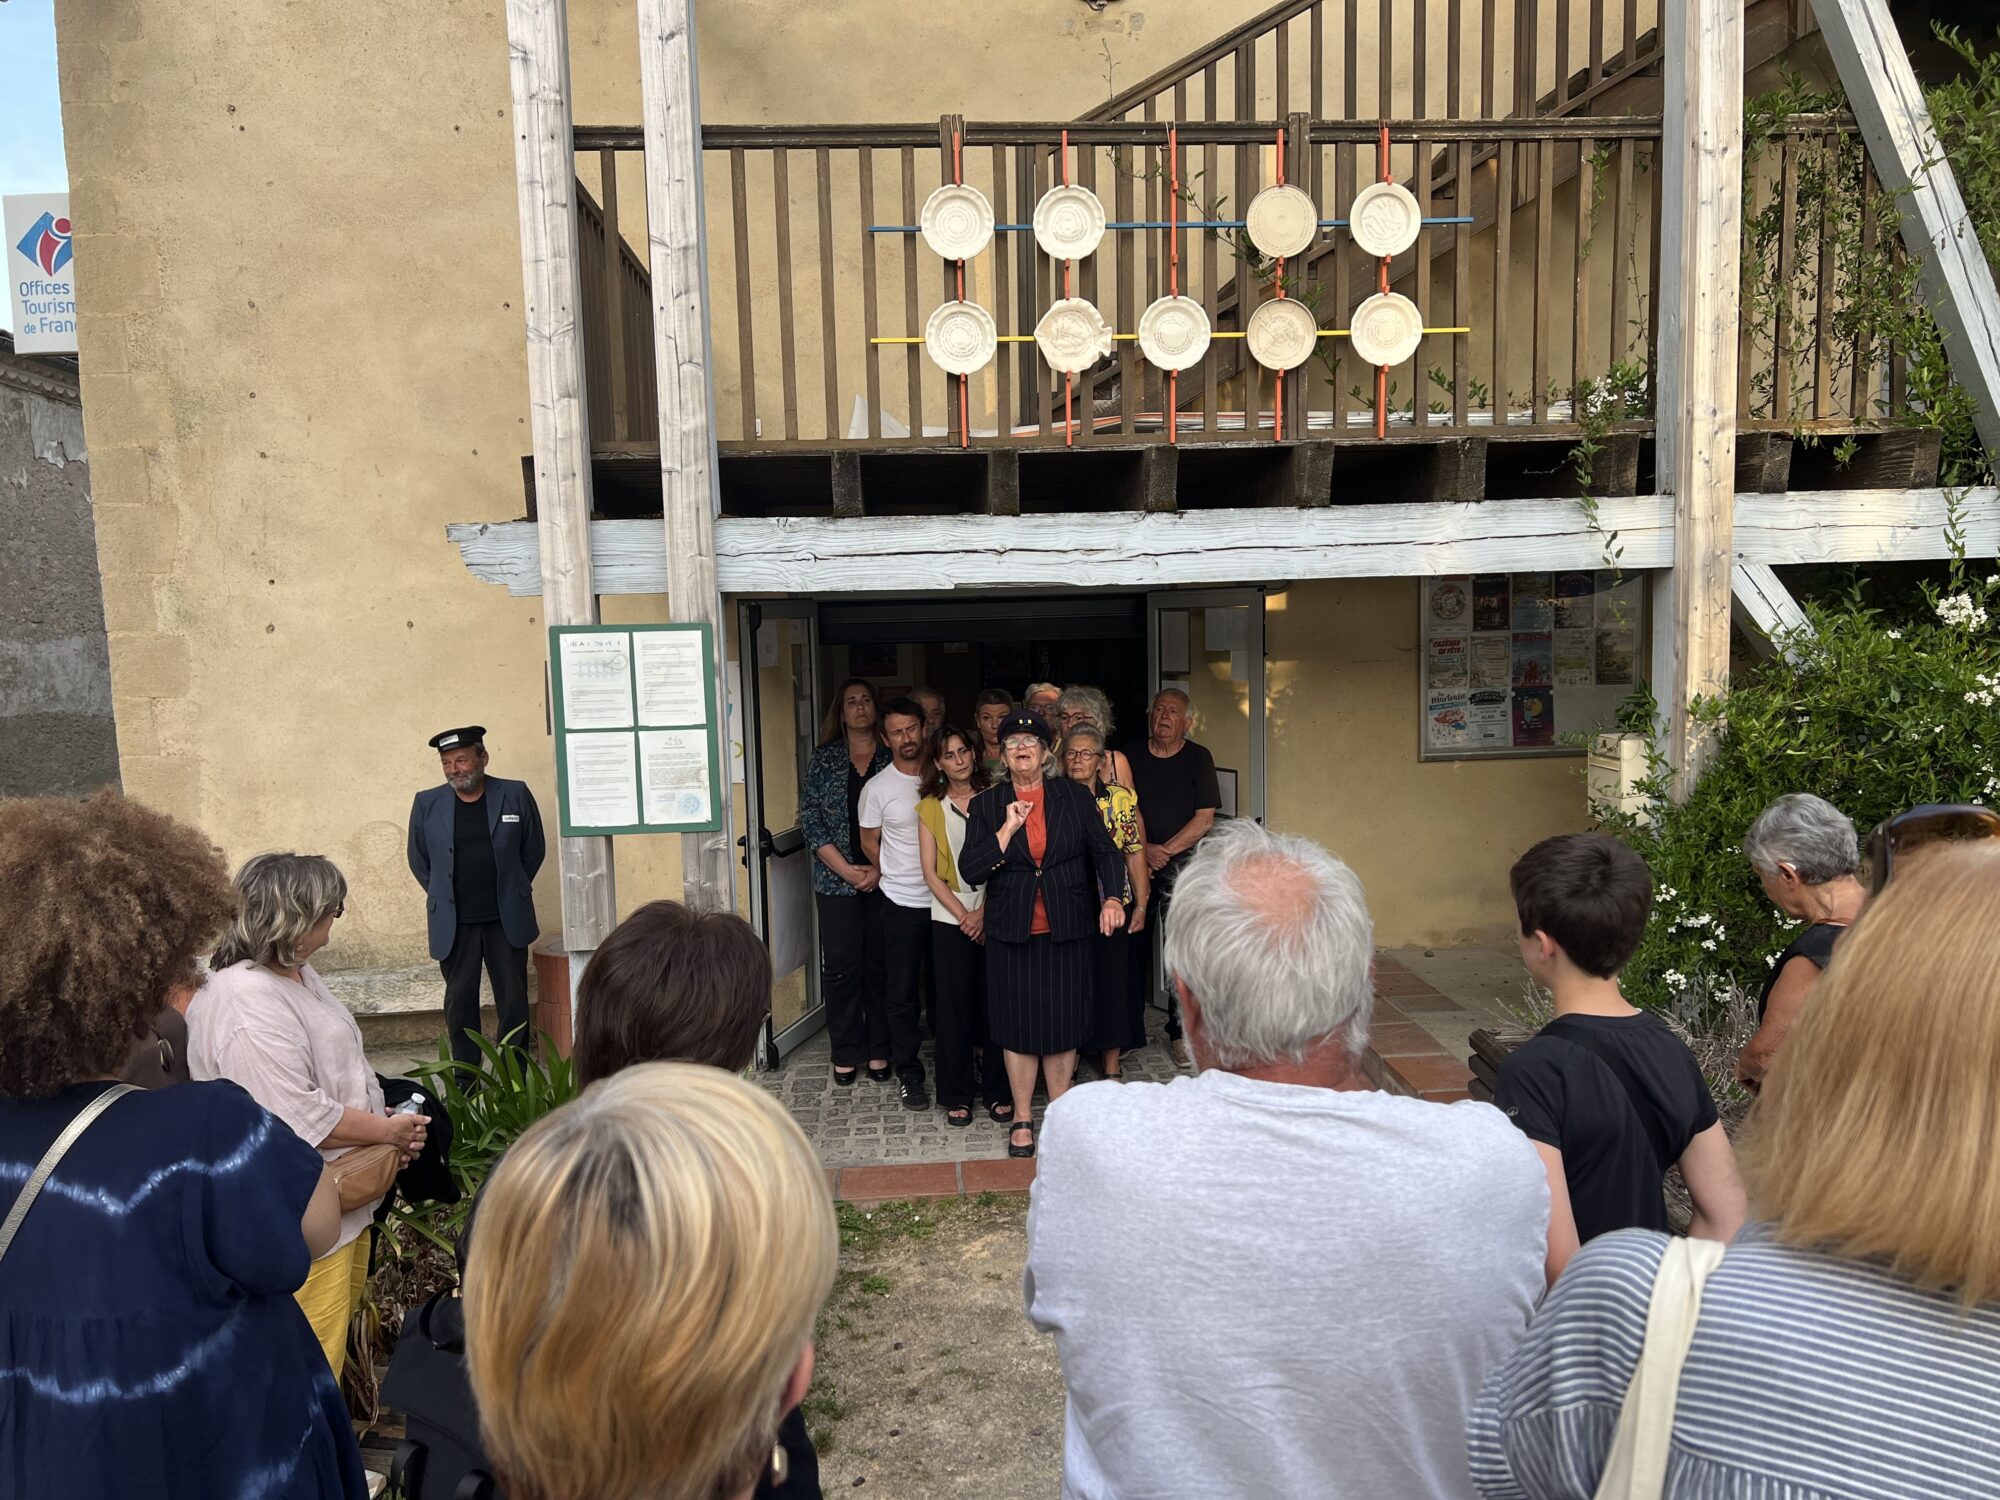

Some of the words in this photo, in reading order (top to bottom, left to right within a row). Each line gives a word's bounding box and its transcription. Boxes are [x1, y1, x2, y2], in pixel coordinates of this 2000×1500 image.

[20, 280, 70, 296] Offices
[24, 323, 36, 334] de
[40, 317, 77, 333] Fran
